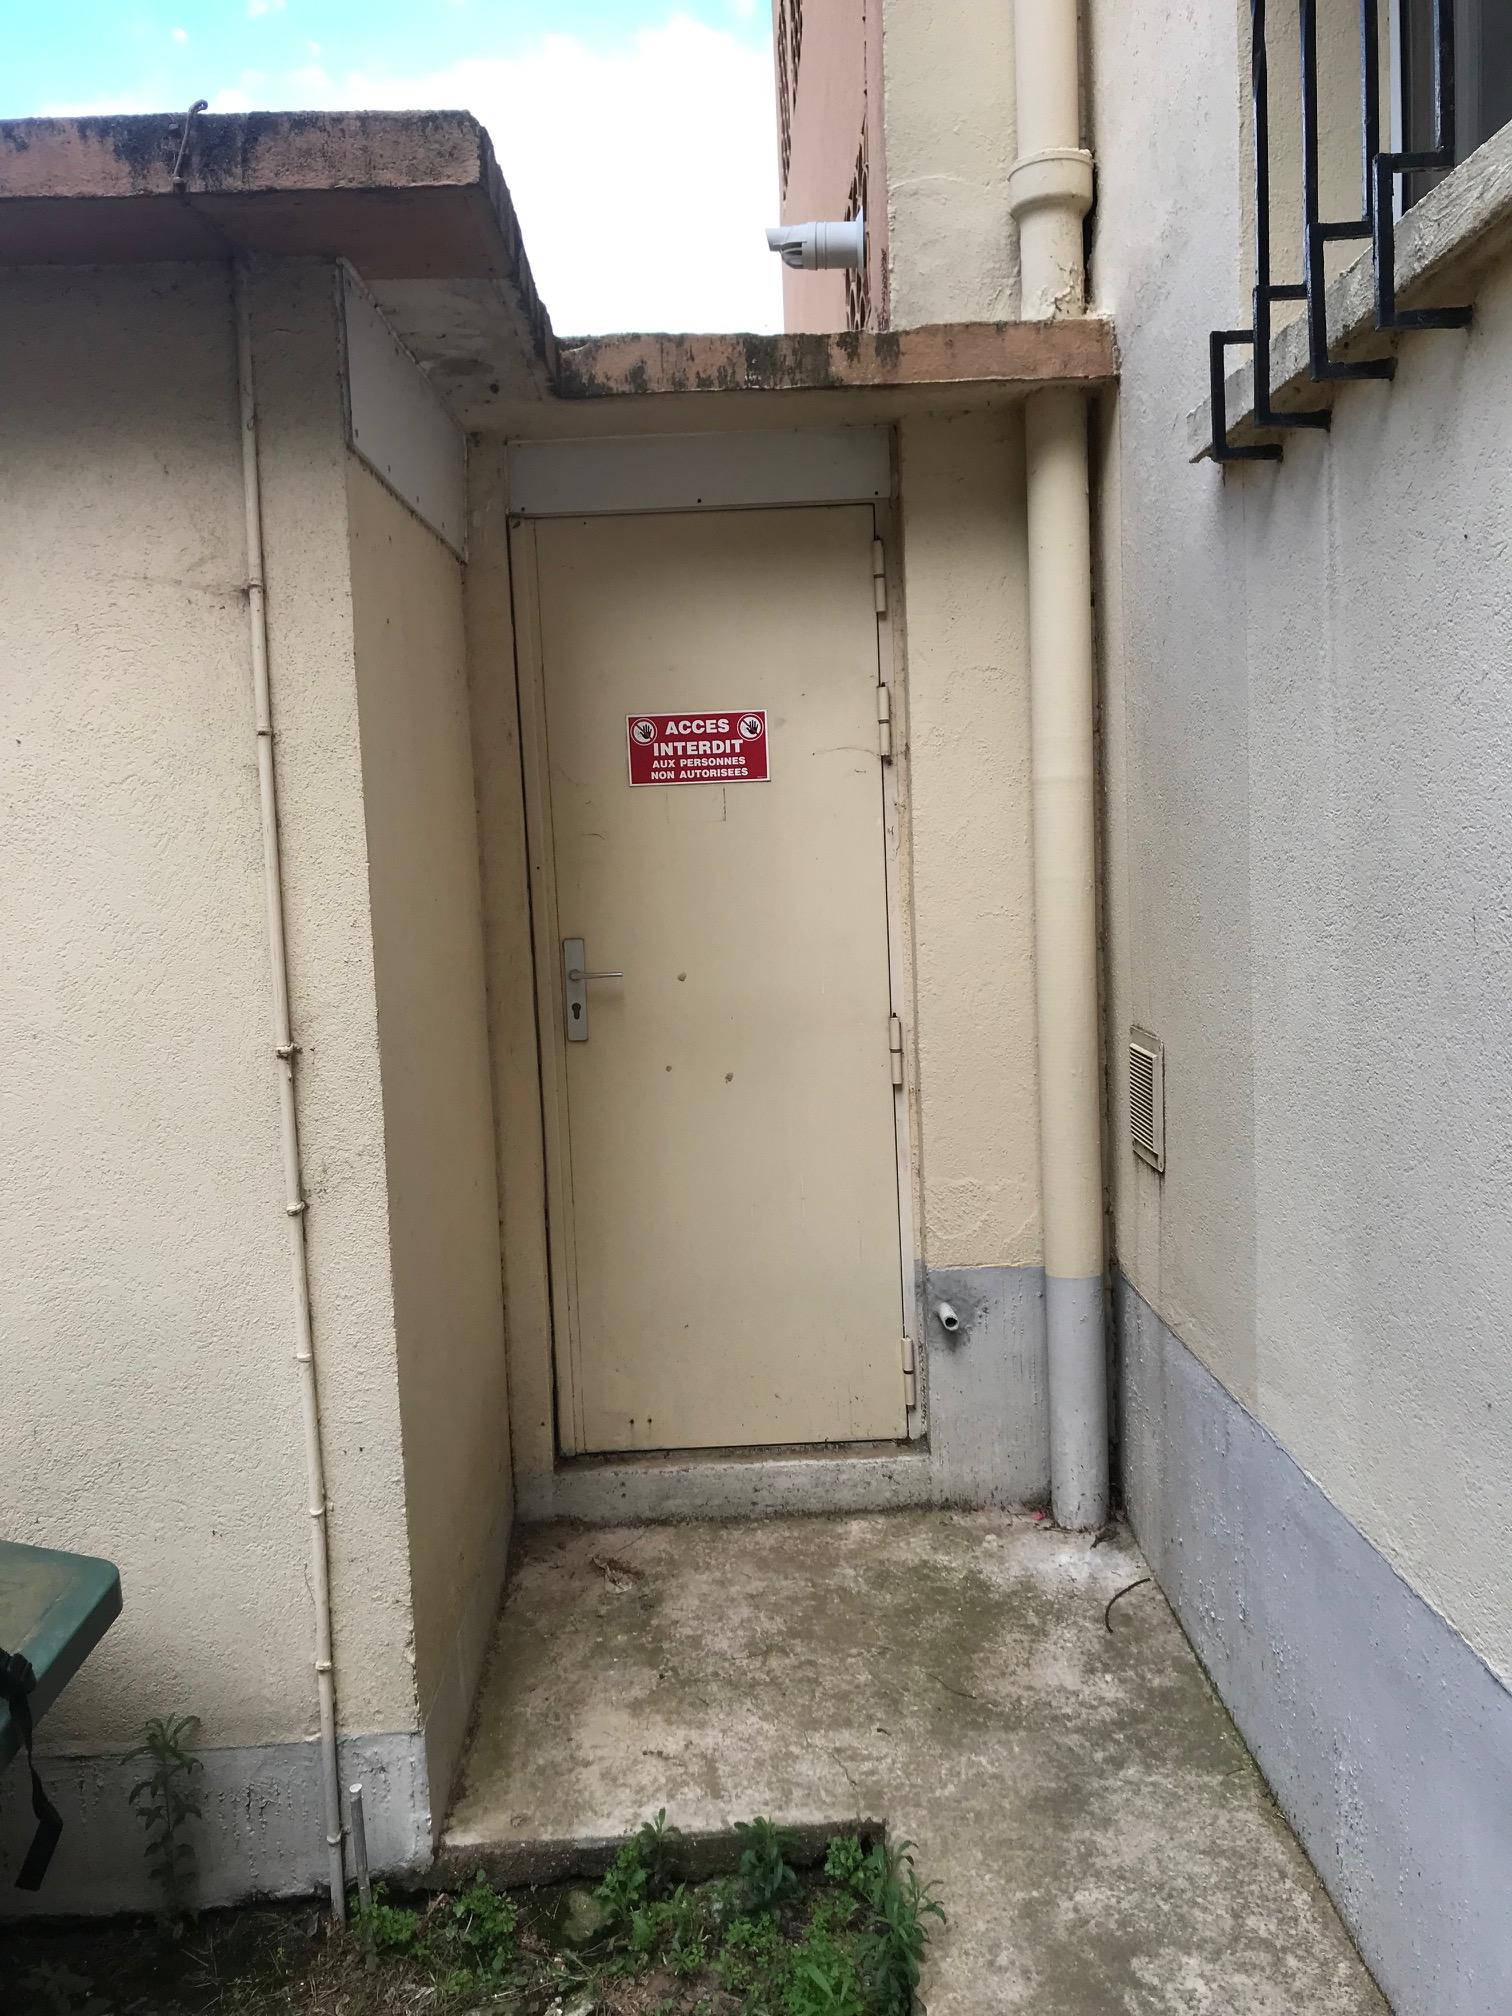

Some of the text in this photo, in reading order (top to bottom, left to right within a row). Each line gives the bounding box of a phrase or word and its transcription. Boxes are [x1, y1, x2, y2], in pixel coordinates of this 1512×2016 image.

[665, 718, 730, 735] ACCES
[653, 739, 744, 756] INTERDIT
[652, 756, 746, 768] AUX PERSONNES
[651, 767, 748, 779] NON AUTORISEES
